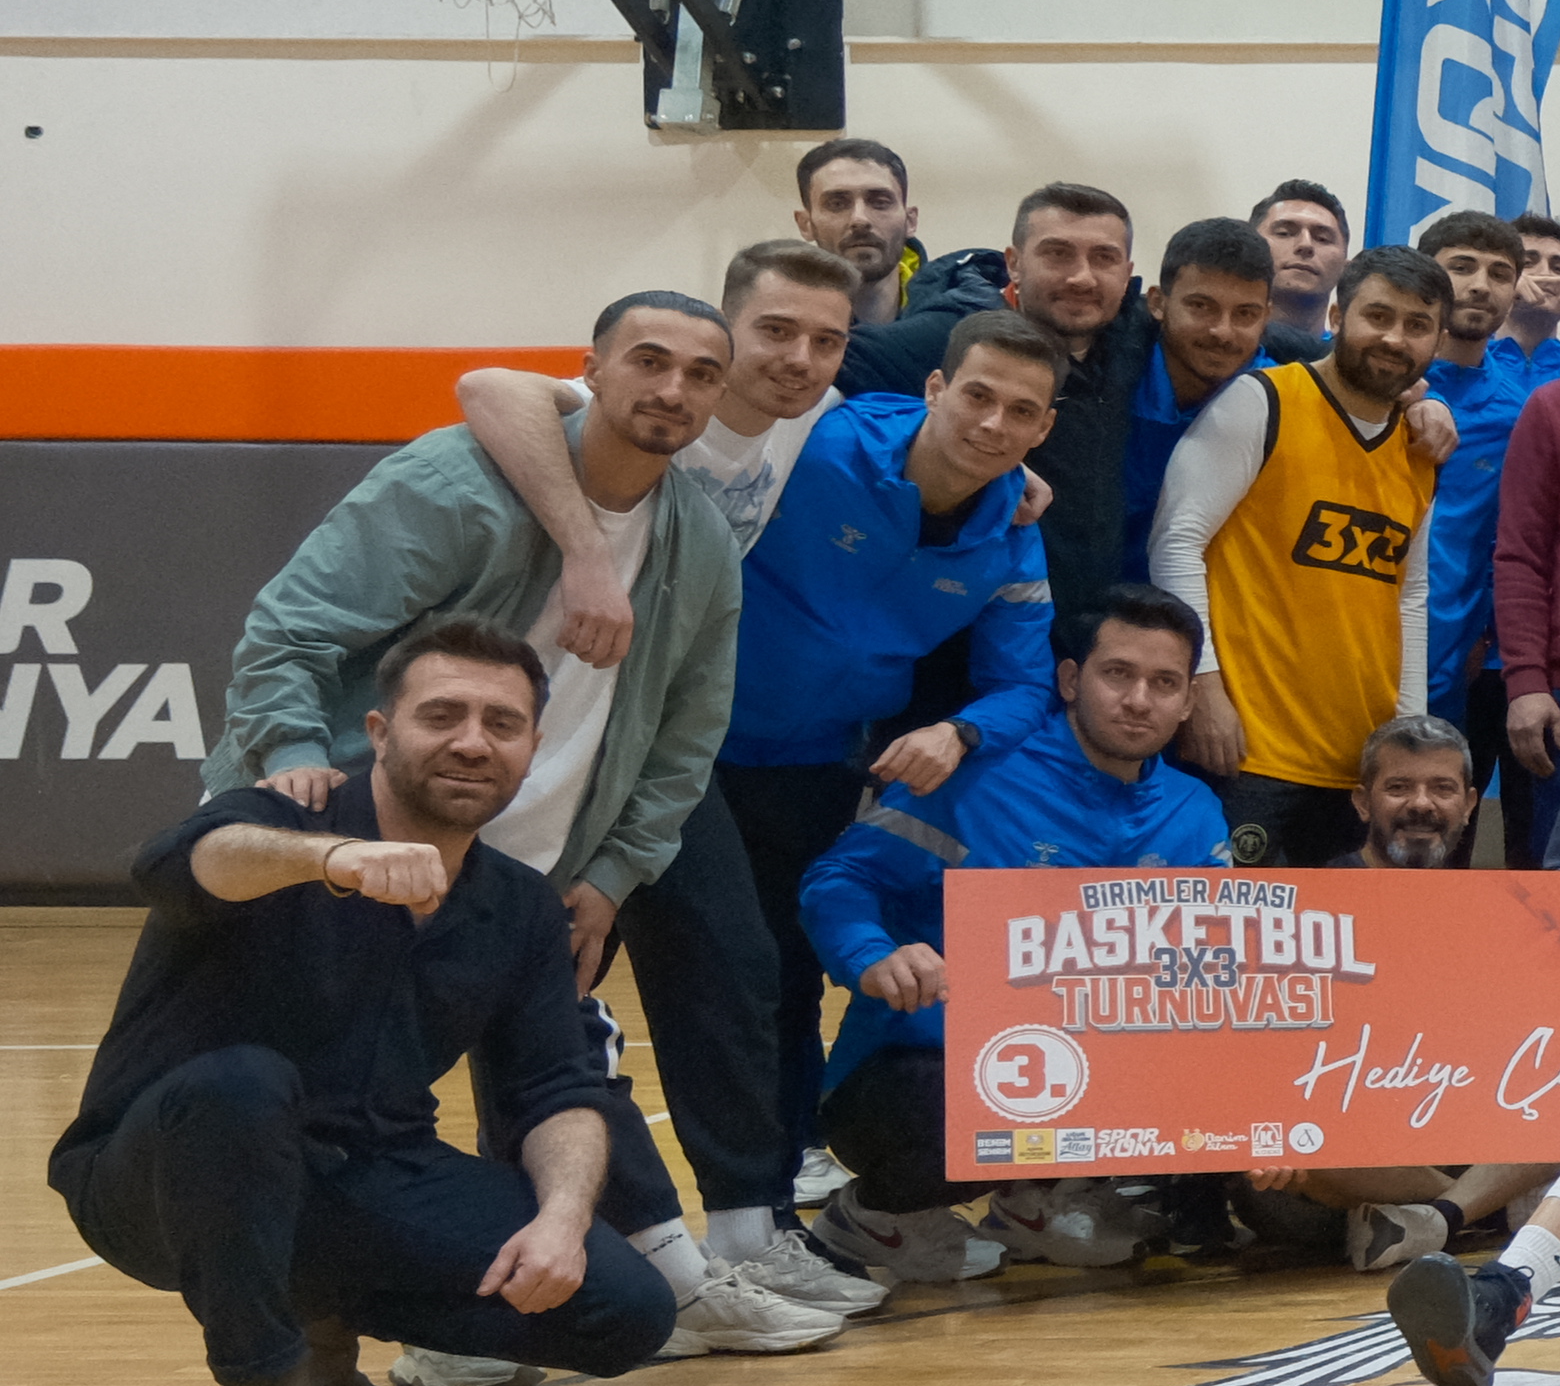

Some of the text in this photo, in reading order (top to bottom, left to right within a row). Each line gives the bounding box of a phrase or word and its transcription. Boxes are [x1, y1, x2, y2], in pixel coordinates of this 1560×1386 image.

[1216, 880, 1297, 911] ARASI
[1007, 904, 1376, 979] BASKETBOL
[1153, 946, 1238, 990] 3X3
[1052, 974, 1334, 1031] TURNUVASI
[996, 1043, 1067, 1100] 3.
[1293, 1023, 1476, 1129] Hediye
[1098, 1128, 1159, 1145] SPOR
[1098, 1141, 1176, 1158] KONYA
